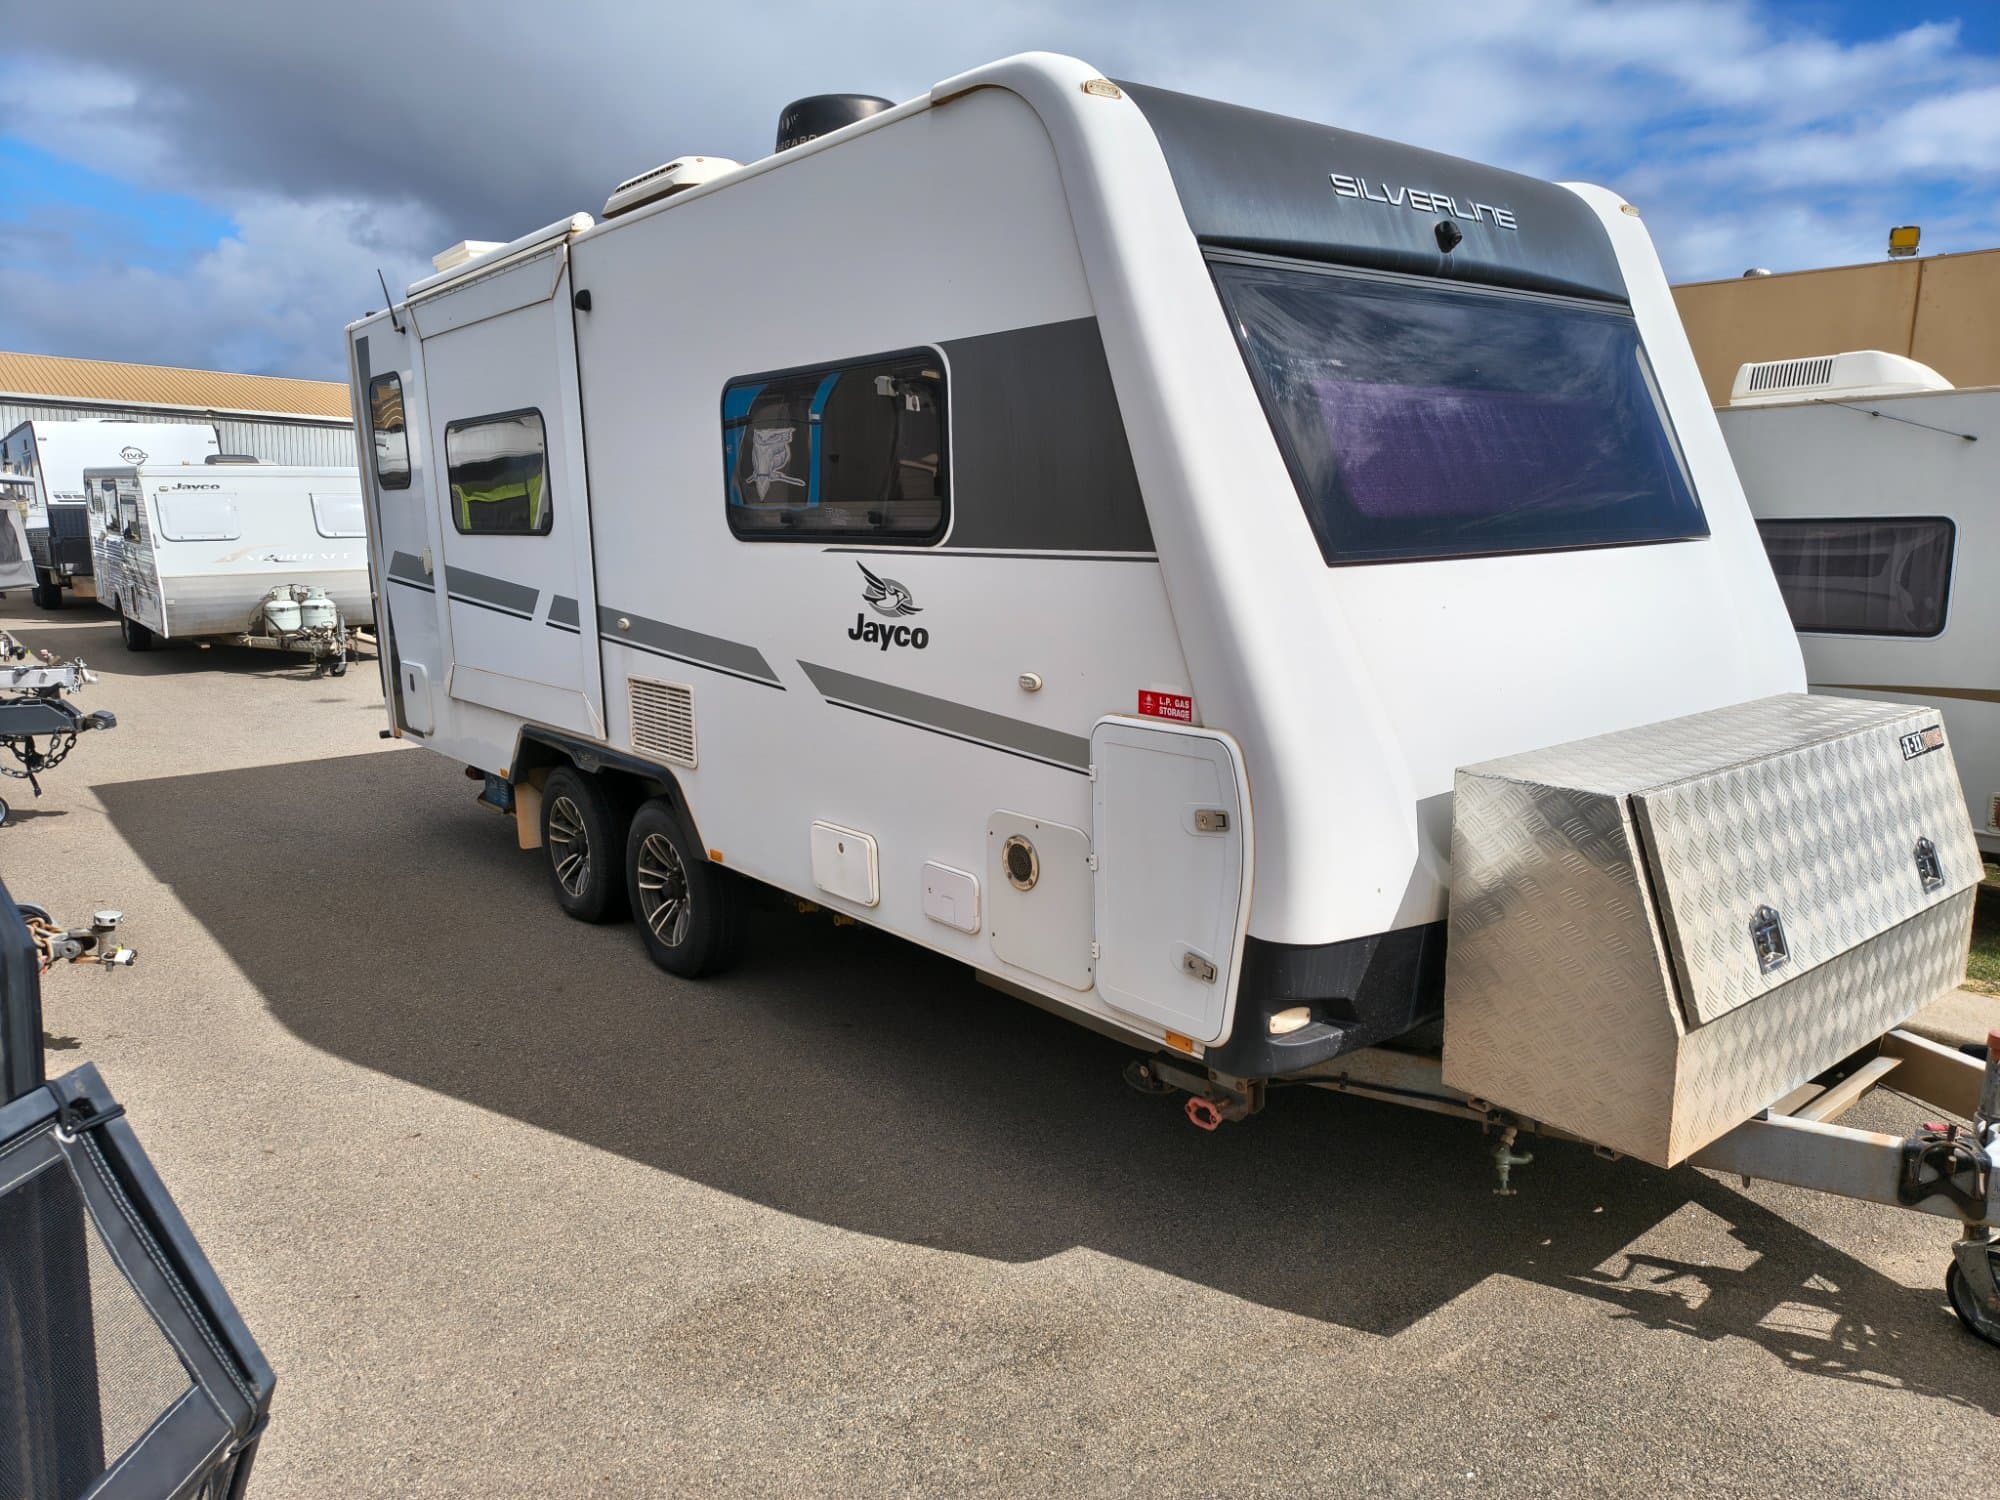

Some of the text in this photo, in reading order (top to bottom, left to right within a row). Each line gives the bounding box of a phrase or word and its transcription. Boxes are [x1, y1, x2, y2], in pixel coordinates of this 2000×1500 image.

[1329, 173, 1518, 230] SILVERLINE
[171, 482, 221, 491] Jayco
[848, 613, 929, 651] Jayco
[1174, 699, 1190, 709] GAS
[1159, 707, 1190, 718] STORAGE
